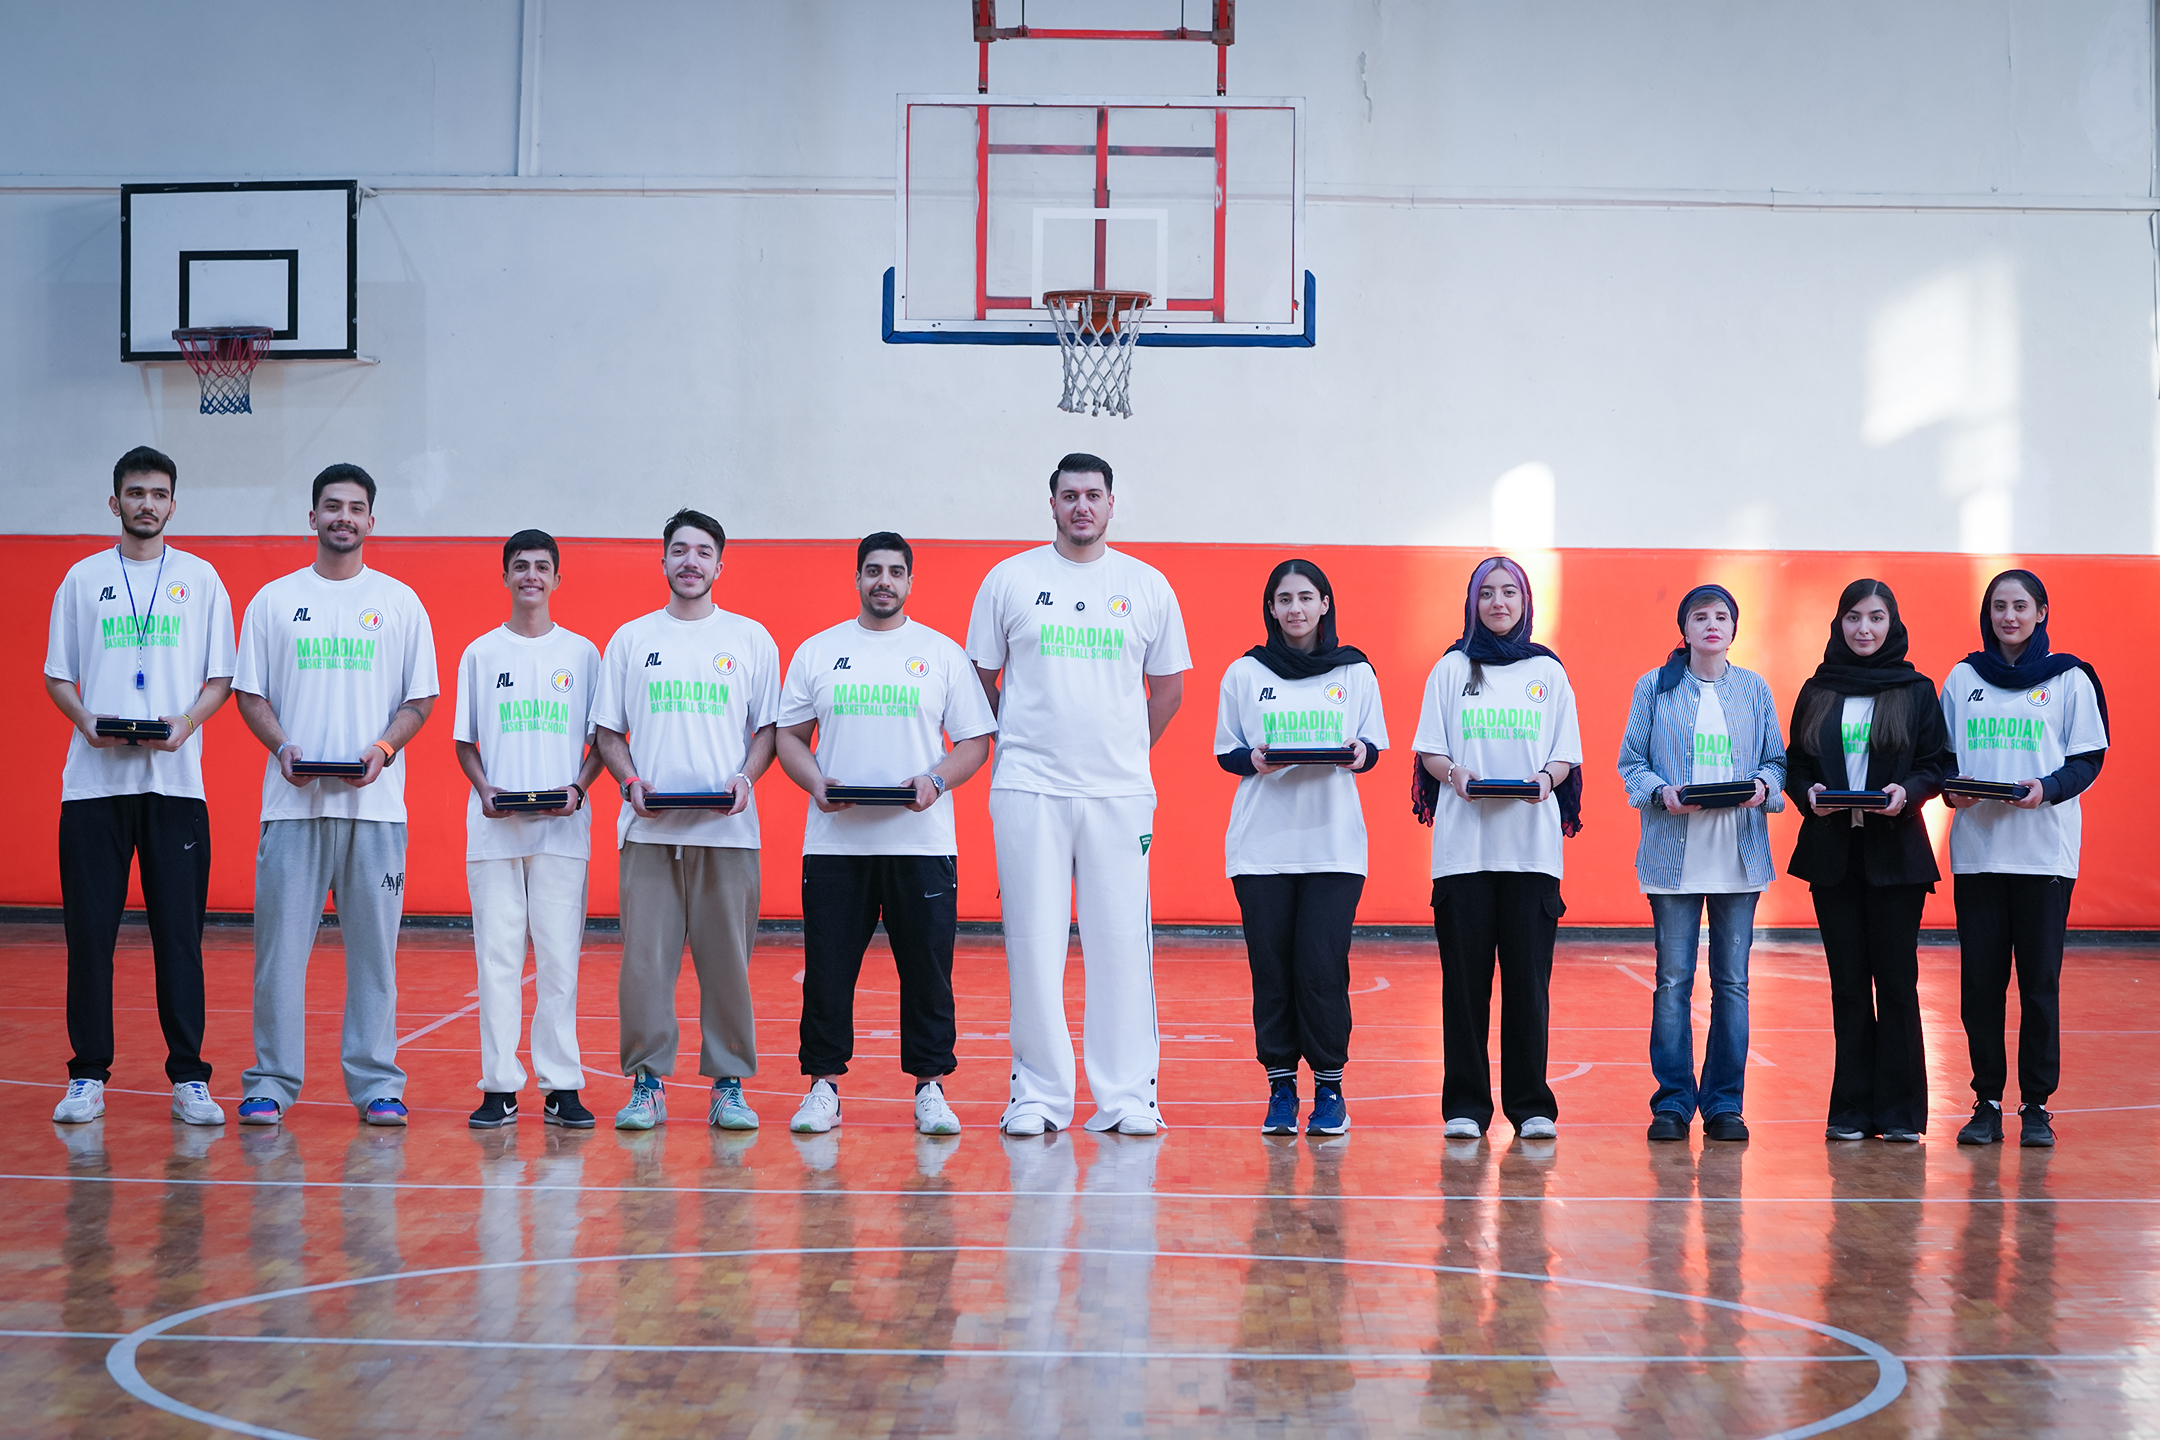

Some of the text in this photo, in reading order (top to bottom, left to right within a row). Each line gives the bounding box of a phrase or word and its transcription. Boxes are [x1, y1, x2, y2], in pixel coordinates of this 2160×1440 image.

[99, 586, 117, 601] AL
[1035, 591, 1053, 606] AL
[293, 608, 311, 622] AL
[102, 615, 180, 638] MADADIAN
[151, 635, 179, 648] SCHOOL
[1041, 624, 1124, 649] MADADIAN
[297, 638, 375, 660] MADADIAN
[1041, 645, 1121, 661] BASKETBALL SCHOOL
[298, 658, 372, 671] BASKETBALL SCHOOL
[645, 652, 662, 667] AL
[833, 657, 851, 670] AL
[496, 672, 514, 688] AL
[649, 680, 729, 704] MADADIAN
[834, 684, 919, 706] MADADIAN
[1259, 687, 1277, 702] AL
[1967, 689, 1985, 703] AL
[651, 701, 725, 716] BASKETBALL SCHOOL
[834, 704, 917, 718] BASKETBALL SCHOOL
[1263, 710, 1344, 733] MADADIAN
[1462, 708, 1542, 730] MADADIAN
[1463, 727, 1510, 741] BASKETBALL
[1967, 717, 2044, 741] MADADIAN
[1265, 731, 1343, 744] BASKETBALL SCHOOL
[2011, 739, 2041, 752] SCHOOL
